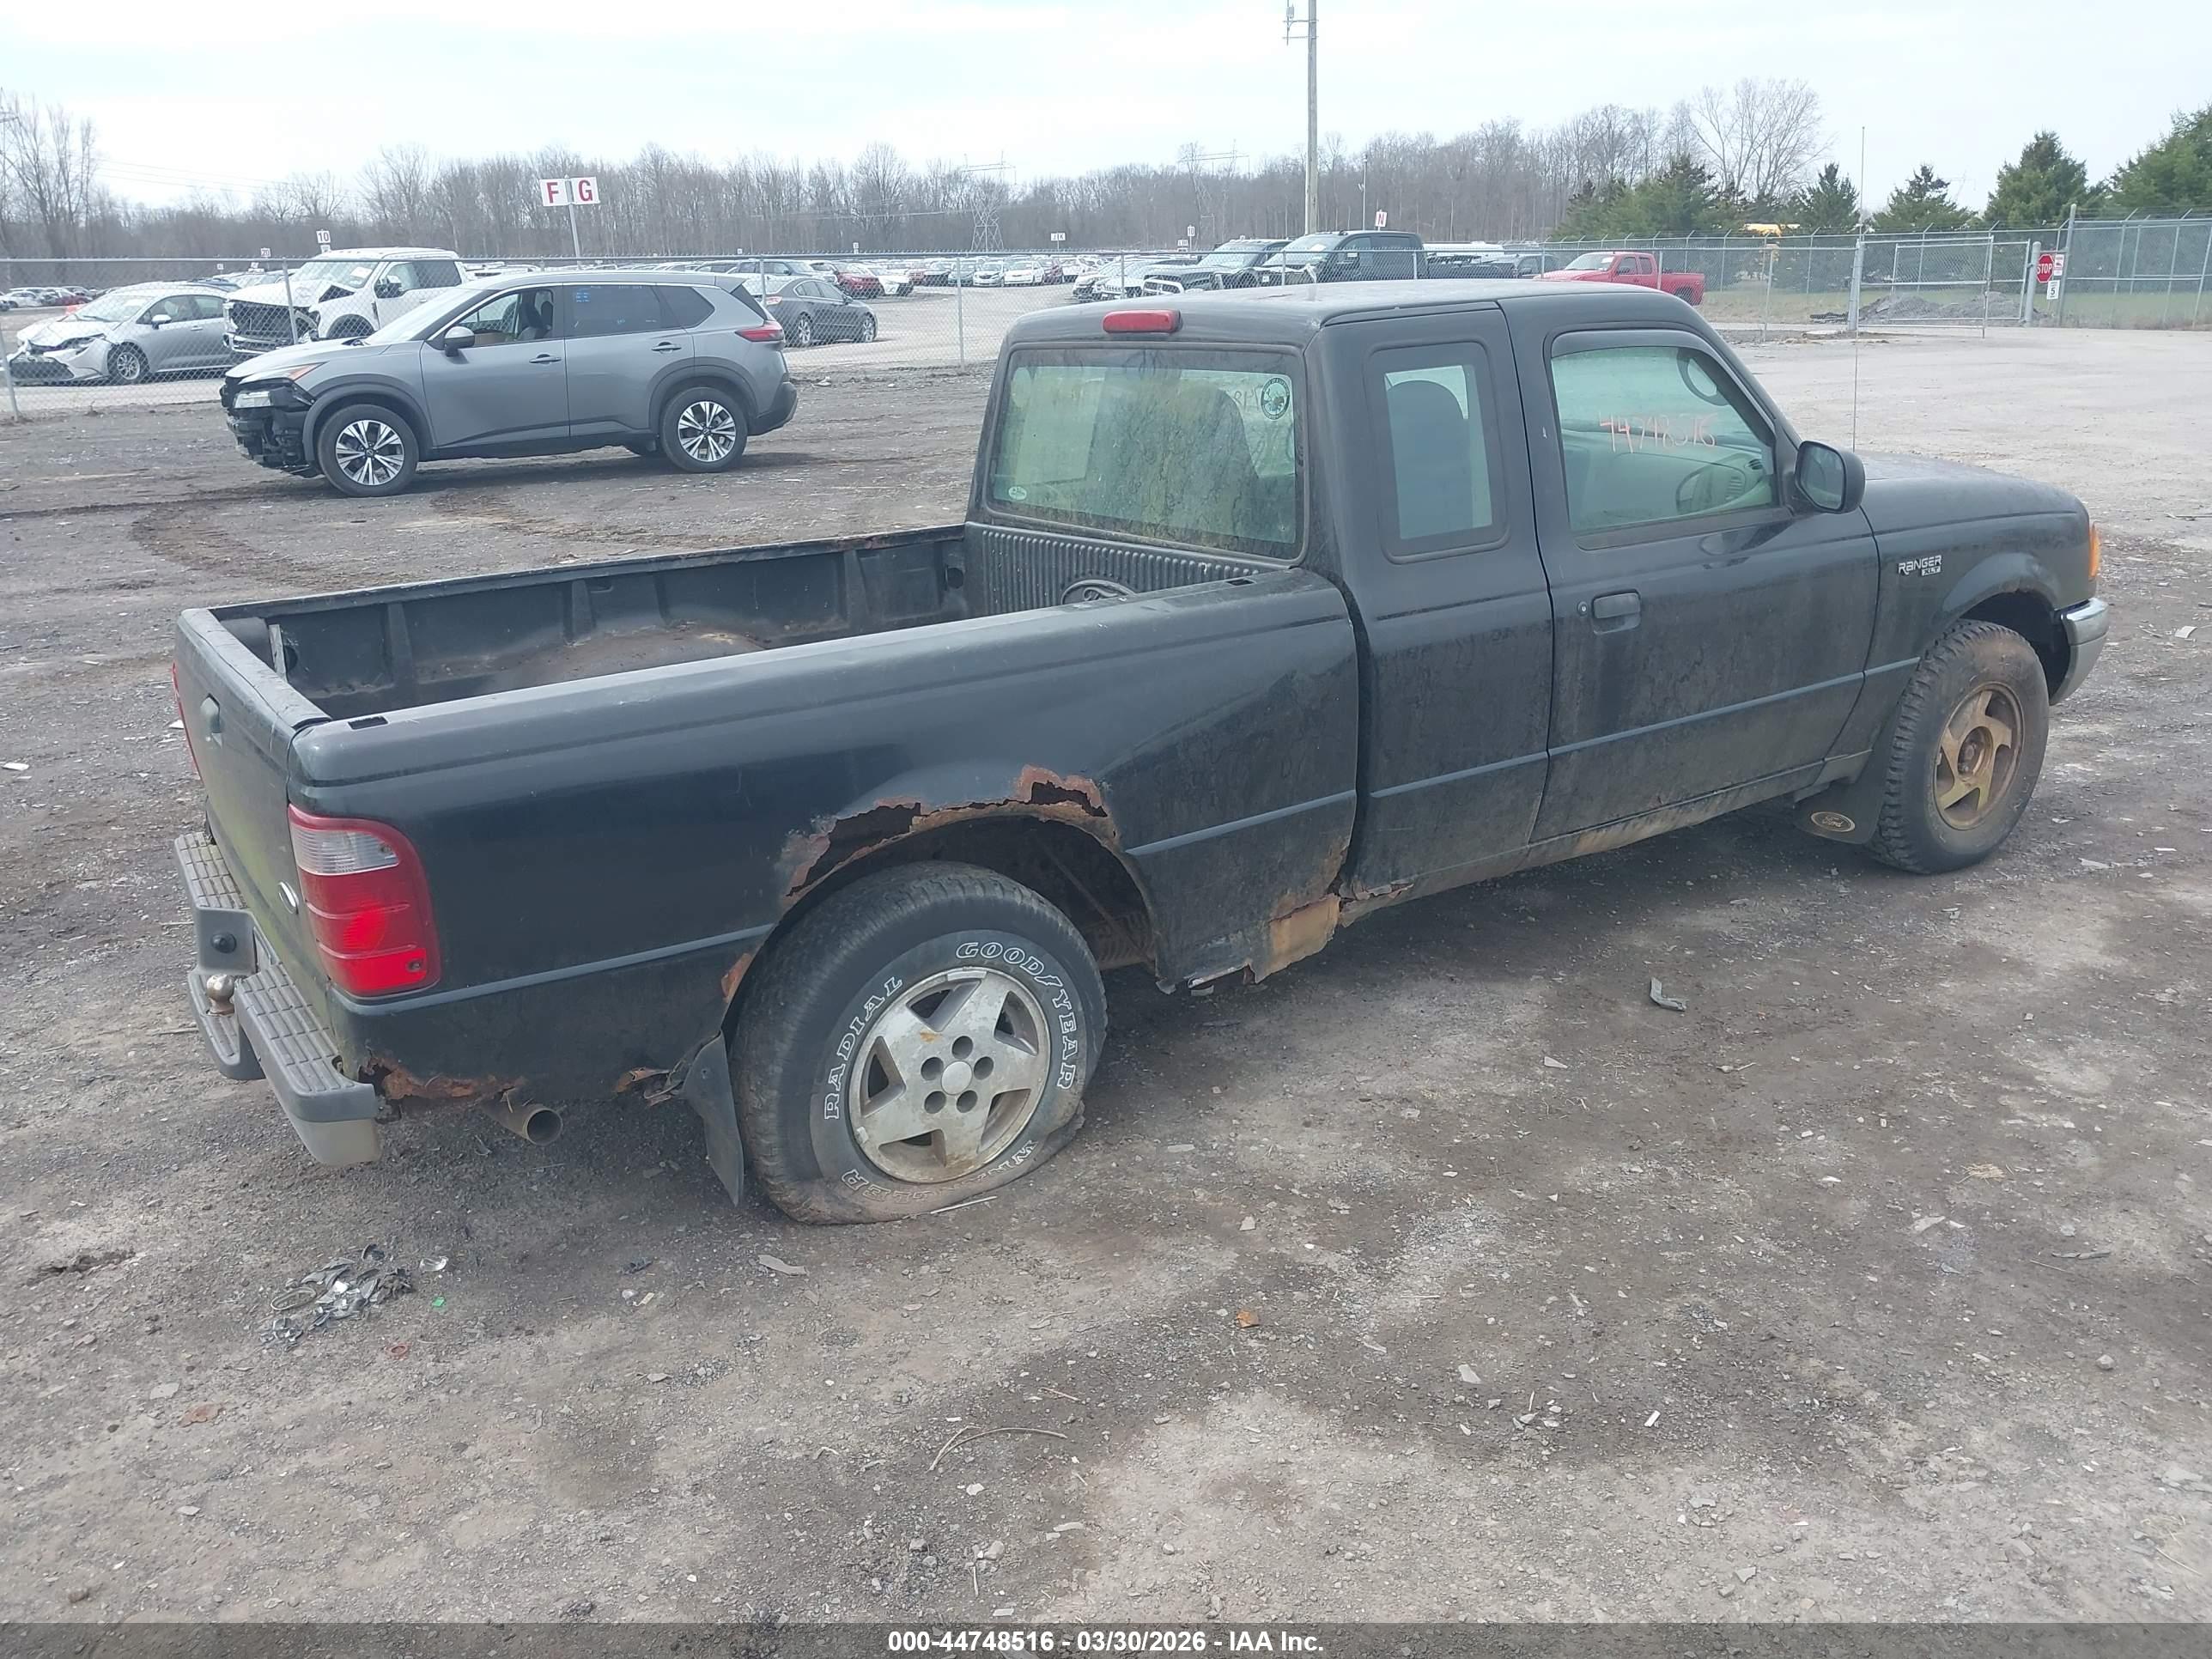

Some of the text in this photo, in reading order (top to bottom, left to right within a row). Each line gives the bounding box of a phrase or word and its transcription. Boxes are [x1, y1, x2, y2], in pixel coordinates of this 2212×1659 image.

[547, 179, 592, 204] F G
[1377, 213, 1384, 225] N
[318, 232, 330, 241] 10
[2037, 263, 2053, 275] STOP
[2051, 287, 2056, 295] 5
[1898, 555, 1942, 575] RANGER
[956, 941, 1079, 1091] GOODYEAR
[823, 975, 904, 1121] RADIAL
